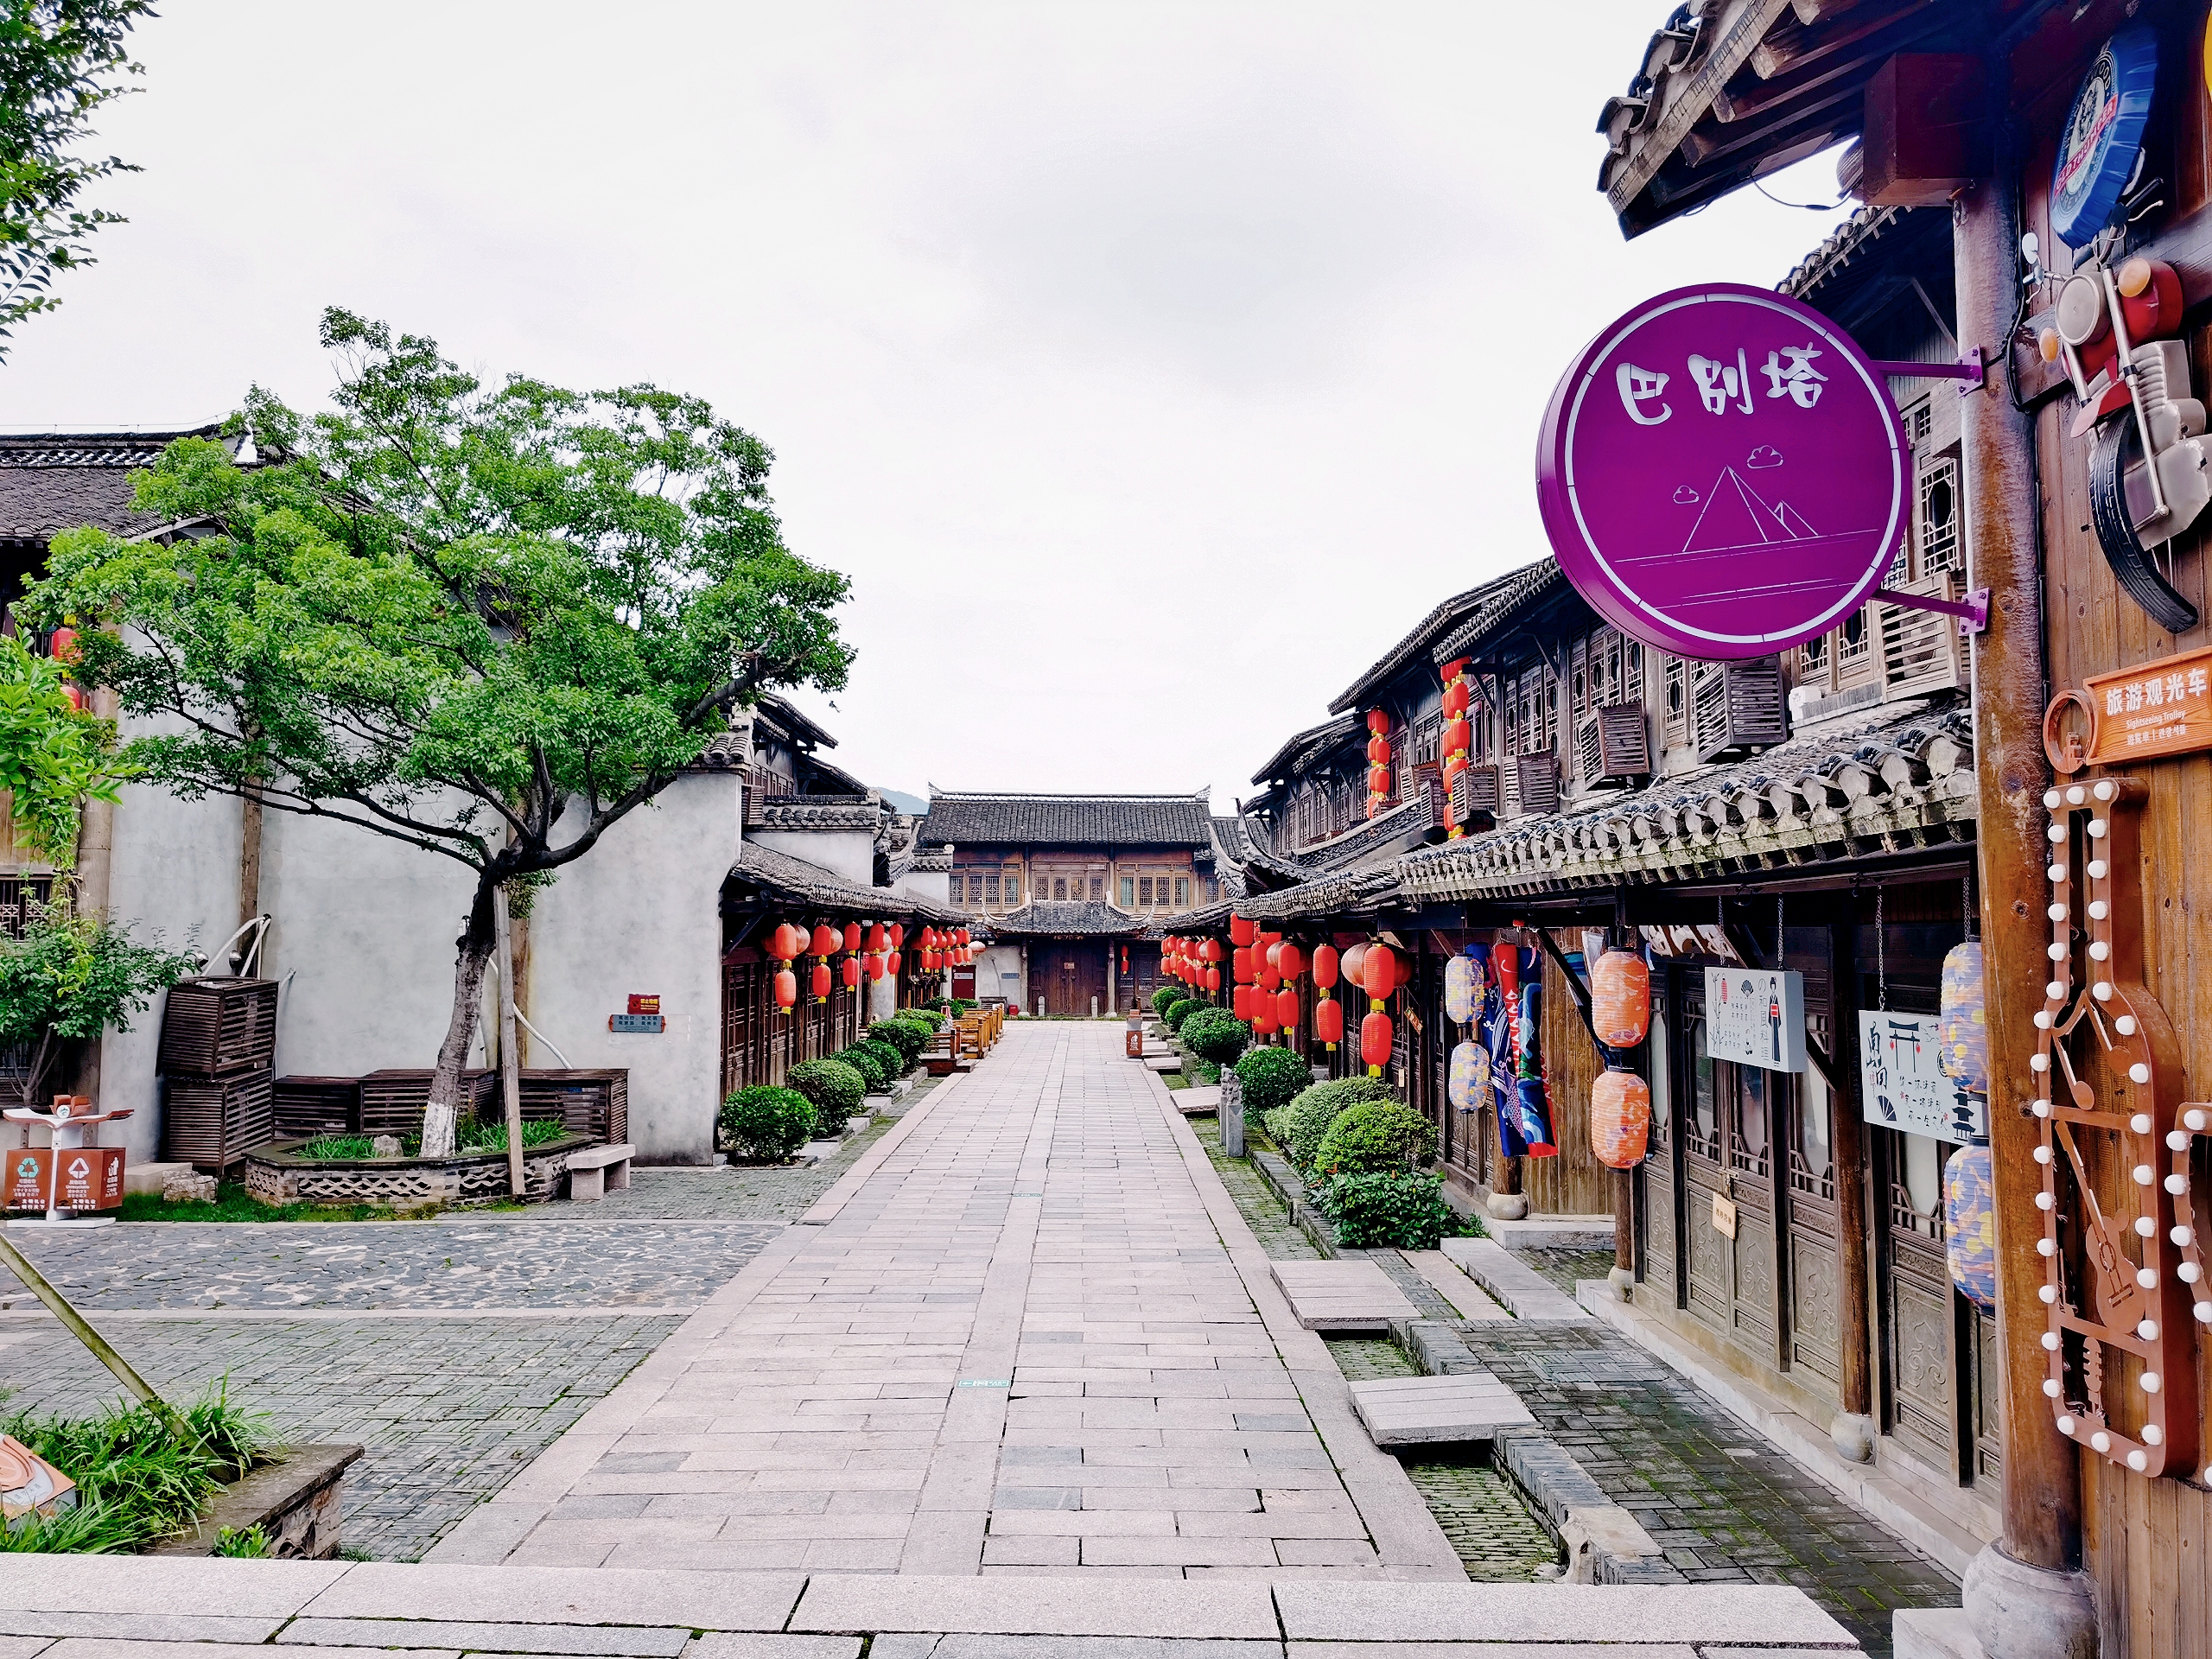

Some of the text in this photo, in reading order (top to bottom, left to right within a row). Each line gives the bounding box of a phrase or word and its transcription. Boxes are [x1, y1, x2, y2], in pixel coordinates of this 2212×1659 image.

[1616, 342, 1829, 426] 巴别塔
[2106, 668, 2208, 716] 旅游观光车
[2126, 714, 2163, 729] Sightseeing
